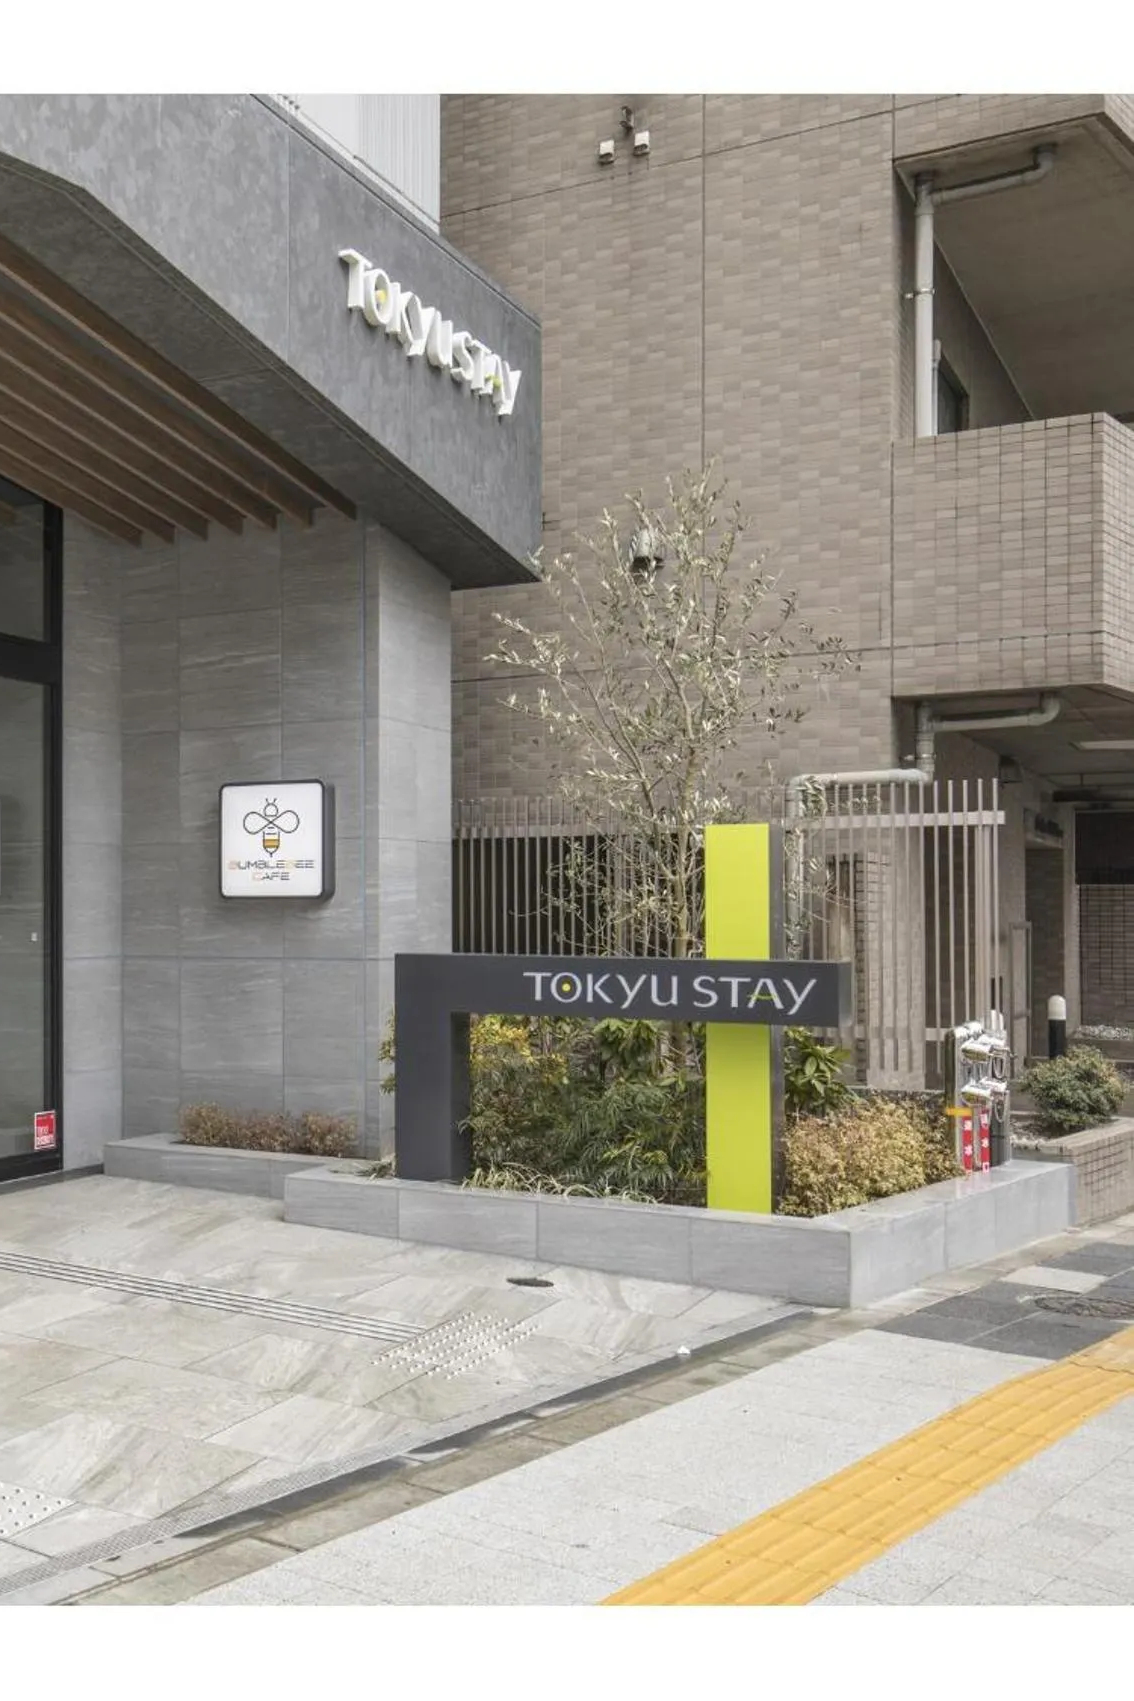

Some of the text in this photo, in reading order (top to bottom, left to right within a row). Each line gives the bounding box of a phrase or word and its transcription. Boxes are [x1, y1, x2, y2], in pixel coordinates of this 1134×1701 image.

[338, 249, 522, 415] TOKYU STAY
[523, 972, 817, 1015] TOKYU STAY
